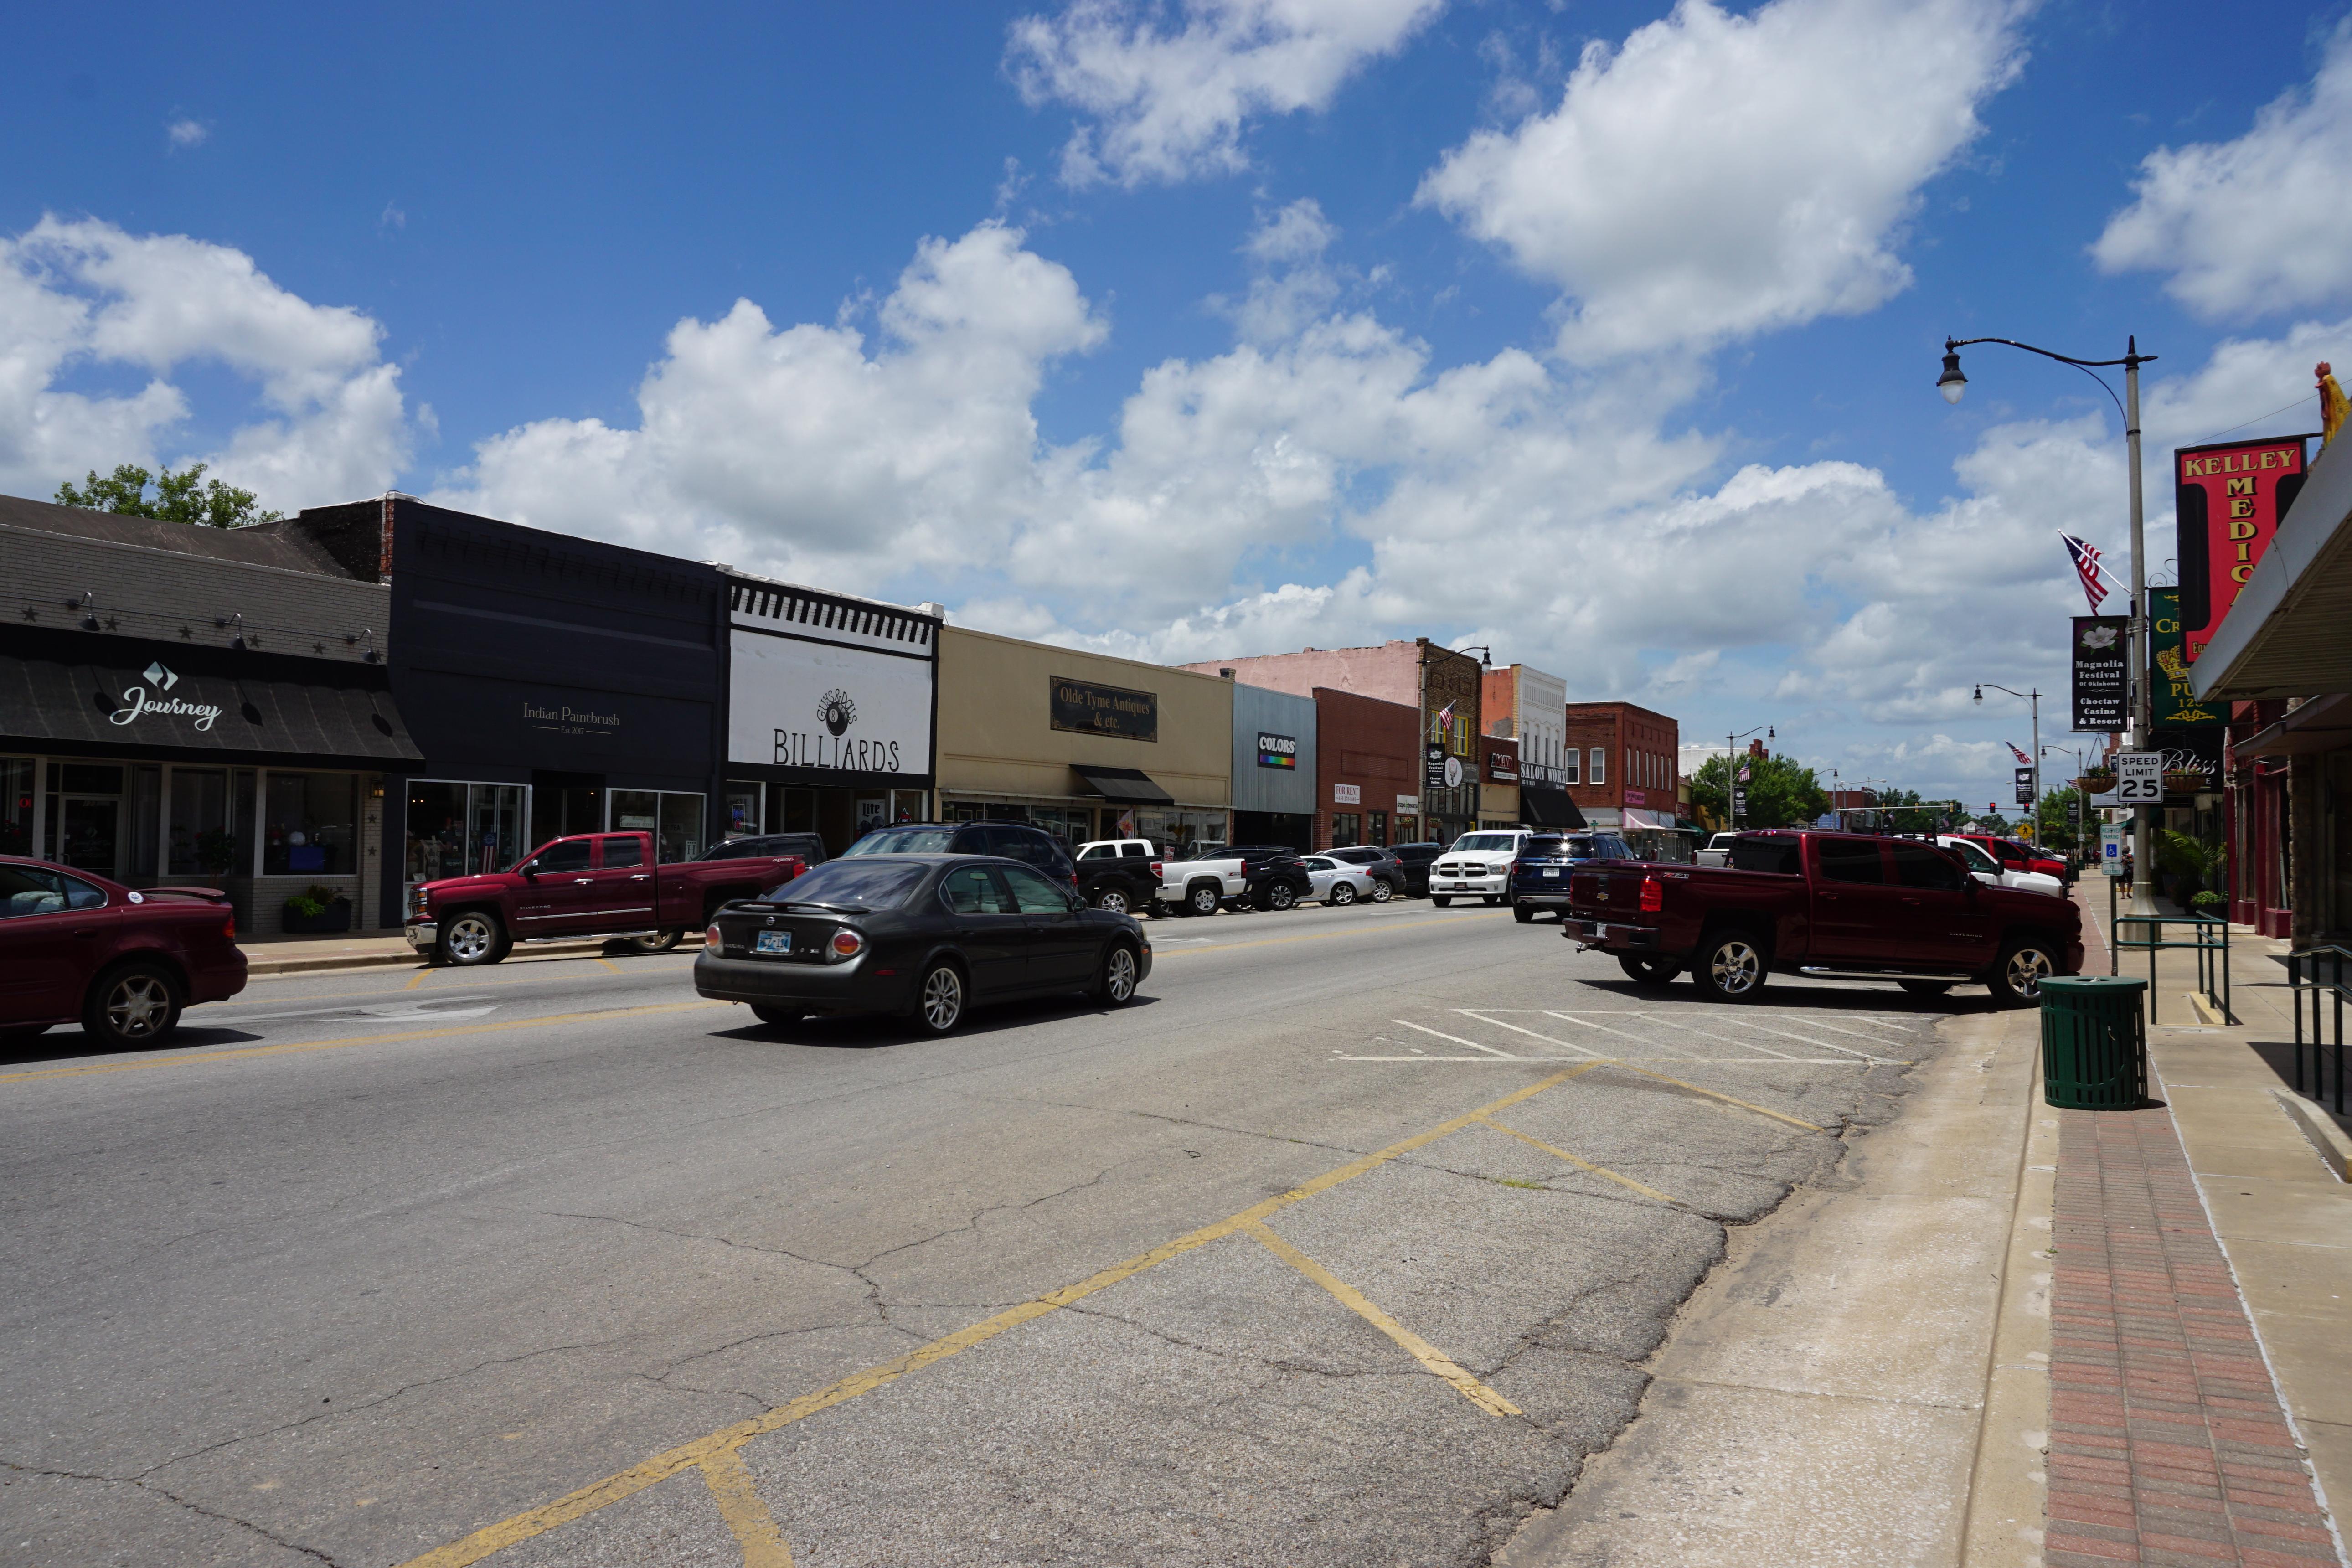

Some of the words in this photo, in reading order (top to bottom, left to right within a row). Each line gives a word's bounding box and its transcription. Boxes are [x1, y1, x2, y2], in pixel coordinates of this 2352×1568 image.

[2184, 449, 2296, 477] KELLEY
[2075, 660, 2124, 670] Magnolia
[109, 686, 222, 731] Journey
[1060, 687, 1083, 704] Olde
[1085, 691, 1110, 710] Tyme
[1112, 696, 1150, 717] Antiques
[523, 702, 558, 720] Indian
[561, 706, 620, 726] Paintbrush
[1094, 712, 1102, 727] &
[1105, 716, 1120, 729] etc.
[773, 728, 899, 772] BILLIARDS
[1259, 736, 1295, 753] COLORS
[1521, 763, 1545, 780] SALON
[1547, 768, 1566, 784] WORX
[1336, 786, 1345, 794] FOR
[1346, 787, 1358, 796] RENT
[2122, 780, 2158, 797] 25
[862, 803, 880, 817] Lite
